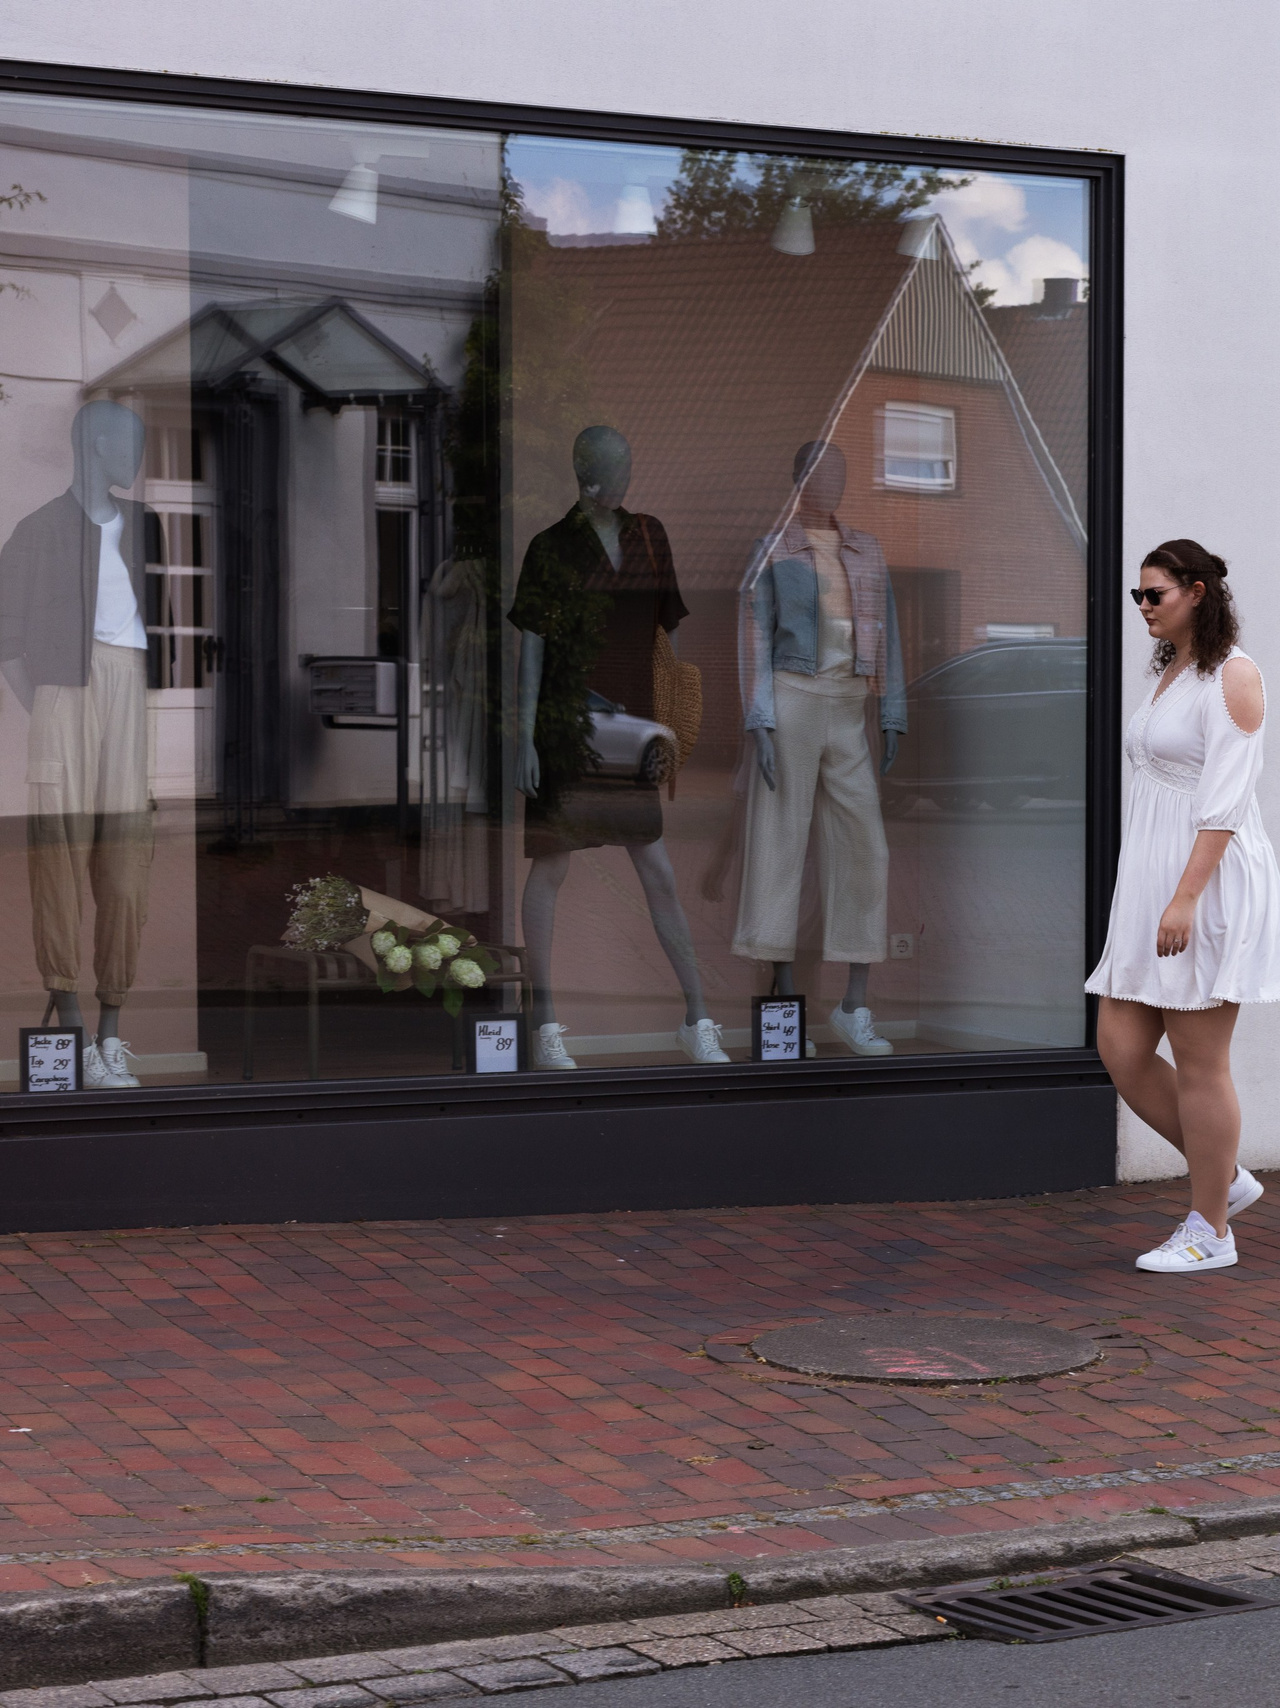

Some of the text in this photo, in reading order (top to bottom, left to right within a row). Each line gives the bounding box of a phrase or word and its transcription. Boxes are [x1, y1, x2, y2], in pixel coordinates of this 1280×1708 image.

[478, 1025, 502, 1036] Kleid
[29, 1036, 52, 1047] Jacke
[761, 1040, 780, 1049] Hose
[28, 1055, 45, 1068] Top
